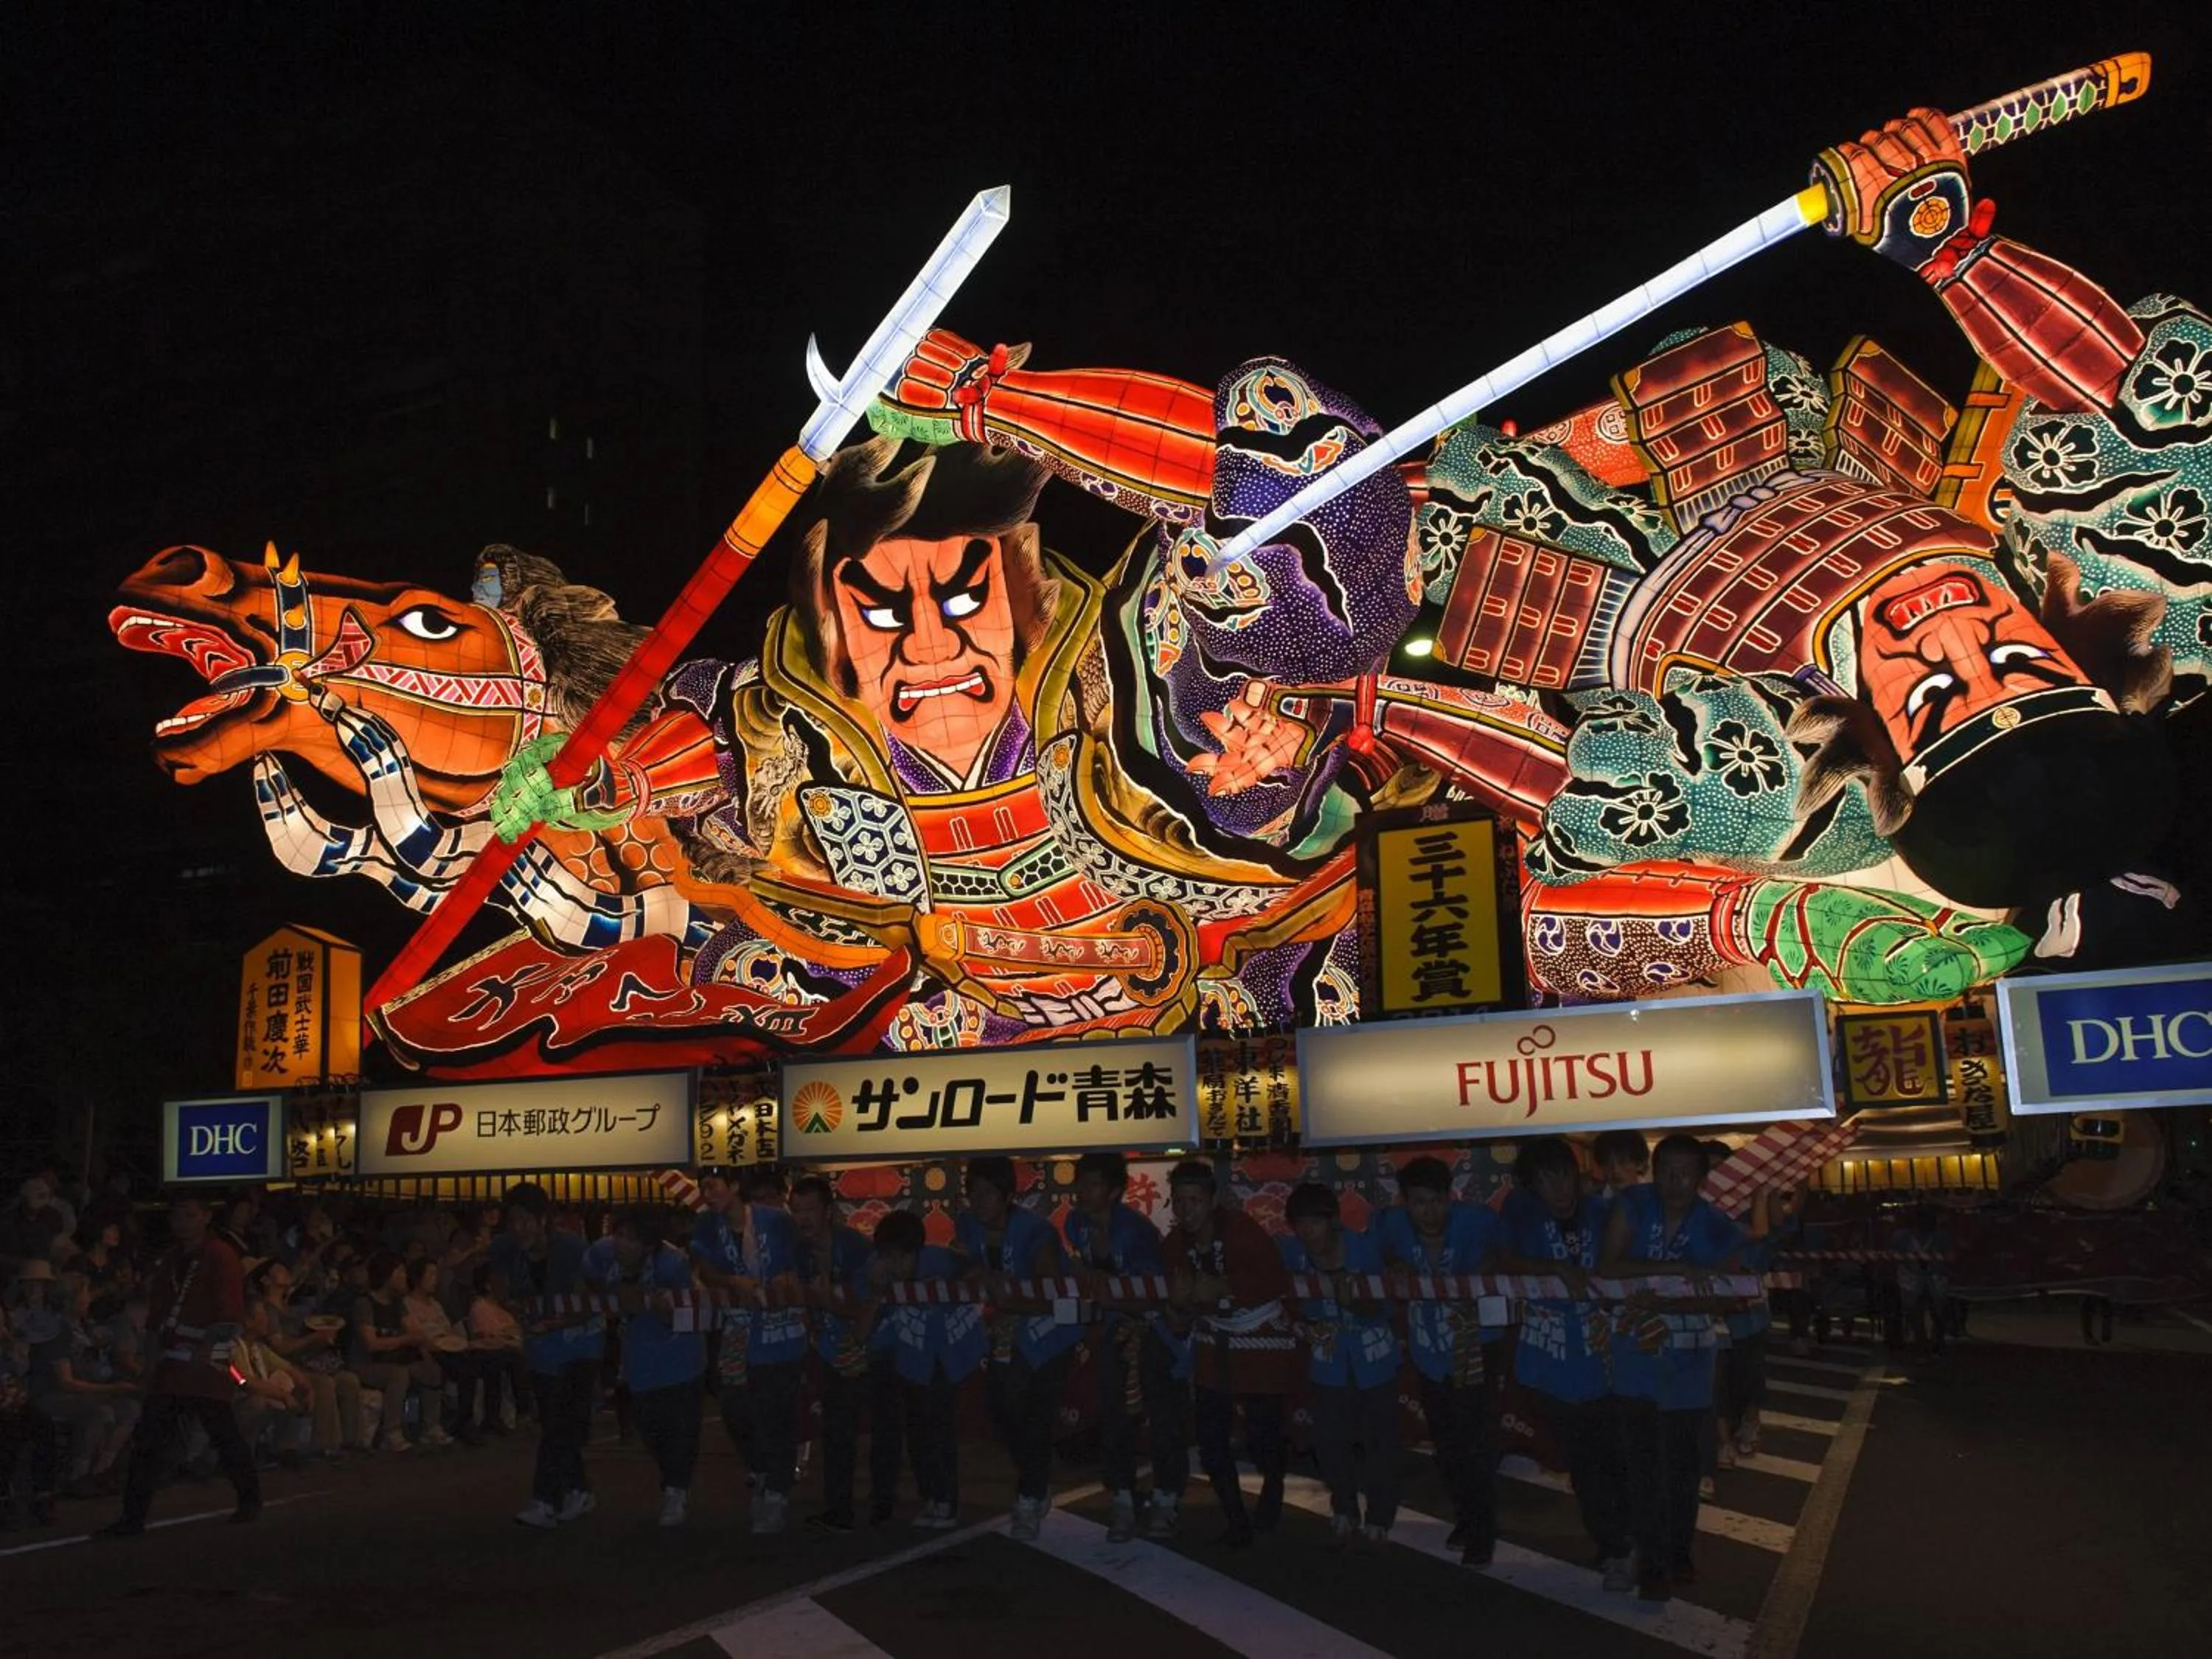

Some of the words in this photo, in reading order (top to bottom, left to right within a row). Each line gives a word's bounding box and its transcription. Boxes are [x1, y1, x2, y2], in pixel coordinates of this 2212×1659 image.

[1408, 831, 1472, 1002] 三十六年賞
[260, 947, 293, 1074] 前田慶次
[2065, 1010, 2212, 1064] DHC
[852, 1060, 1177, 1132] サンロード青森
[1234, 1041, 1263, 1132] 東洋社
[1455, 1049, 1654, 1119] FUJITSU
[189, 1122, 257, 1156] DHC
[476, 1103, 662, 1138] 日本郵政グループ
